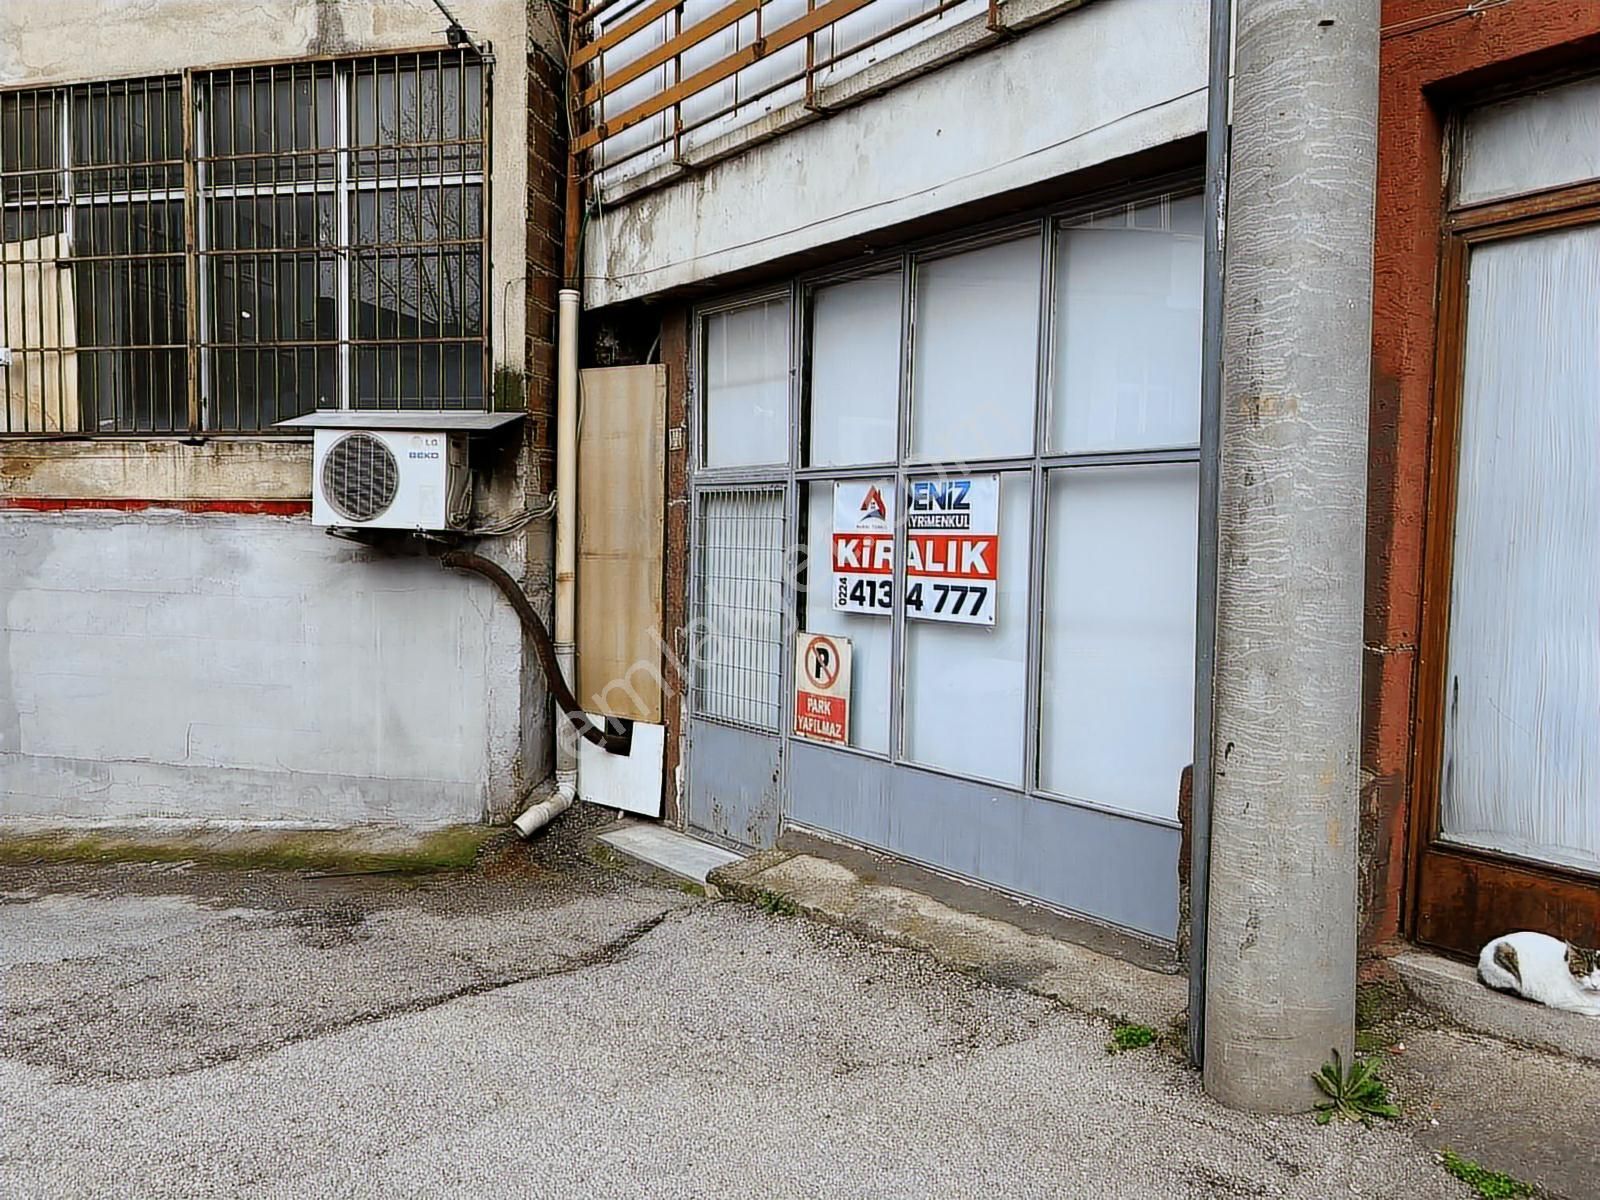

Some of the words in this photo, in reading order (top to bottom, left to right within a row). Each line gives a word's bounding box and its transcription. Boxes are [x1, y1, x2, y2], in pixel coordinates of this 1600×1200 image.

[838, 577, 848, 606] 0224
[933, 584, 988, 617] 777
[807, 697, 832, 716] PARK
[797, 714, 842, 738] YAPILMAZ
